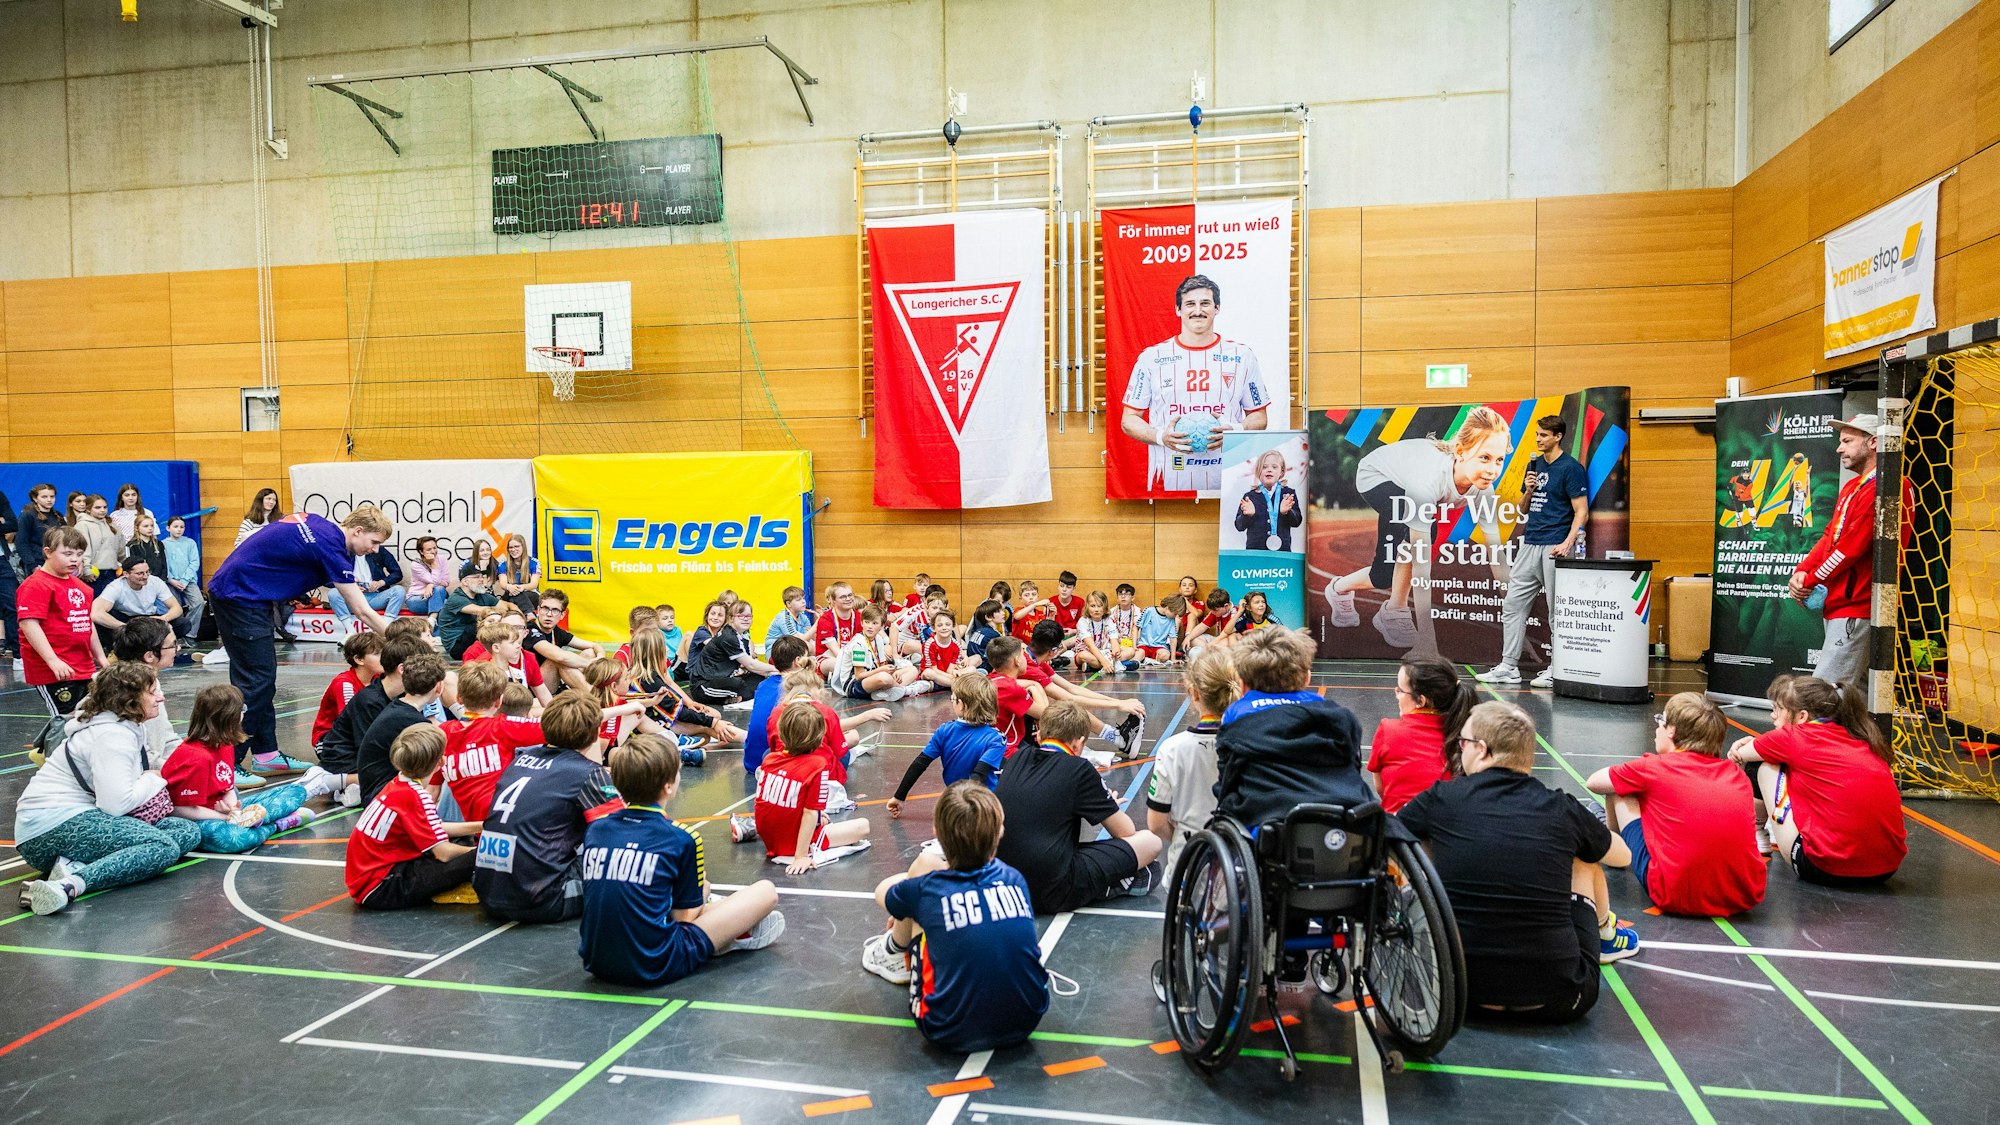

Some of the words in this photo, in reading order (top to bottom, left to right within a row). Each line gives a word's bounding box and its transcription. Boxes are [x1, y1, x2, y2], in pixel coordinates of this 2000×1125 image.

[664, 164, 691, 173] PLAYER
[493, 175, 518, 185] PLAYER
[665, 205, 692, 215] PLAYER
[493, 215, 518, 225] PLAYER
[1118, 224, 1141, 238] För
[1144, 223, 1191, 237] immer
[1198, 221, 1219, 234] rut
[1223, 221, 1240, 232] un
[1245, 216, 1280, 231] wieß
[1142, 244, 1191, 264] 2009
[1199, 242, 1248, 261] 2025
[1831, 246, 1900, 290] bannerstop
[911, 297, 978, 310] Longericher
[980, 294, 1002, 305] S.C.
[942, 370, 956, 380] 19
[960, 369, 974, 379] 26
[1186, 370, 1210, 392] 22
[946, 384, 955, 392] e.
[1784, 414, 1819, 428] KÖLN
[1783, 427, 1807, 435] RHEIN
[1809, 425, 1834, 434] RUHR
[1186, 456, 1222, 466] Engel
[1389, 495, 1454, 524] Der
[610, 515, 791, 556] Engels
[1383, 534, 1429, 564] ist
[1718, 540, 1767, 550] SCHAFFT
[554, 565, 596, 576] EDEKA
[610, 560, 652, 574] Frische
[656, 562, 678, 573] von
[715, 559, 734, 573] bis
[737, 559, 793, 573] Feinkost.
[1232, 568, 1293, 579] OLYMPISCH
[1717, 564, 1736, 574] DIE
[1736, 564, 1773, 575] ALLEN
[1410, 577, 1463, 590] Olympia
[1467, 578, 1490, 590] und
[1716, 581, 1735, 589] Deine
[1736, 582, 1761, 590] Stimme
[1443, 593, 1504, 607] KölnRhein
[1729, 589, 1778, 598] Paralympische
[1555, 595, 1567, 605] Die
[1568, 596, 1620, 610] Bewegung,
[1430, 607, 1466, 620] Dafür
[1469, 609, 1494, 622] sein
[1563, 607, 1624, 621] Deutschland
[301, 618, 334, 634] LSC
[1556, 619, 1573, 629] jetzt
[1575, 619, 1616, 633] braucht.
[458, 743, 502, 778] KÖLN
[514, 754, 554, 770] GOLLA
[761, 769, 802, 808] KÖLN
[493, 776, 532, 825] 4
[479, 836, 510, 858] DKB
[606, 842, 660, 887] KÖLN
[940, 890, 983, 932] LSC
